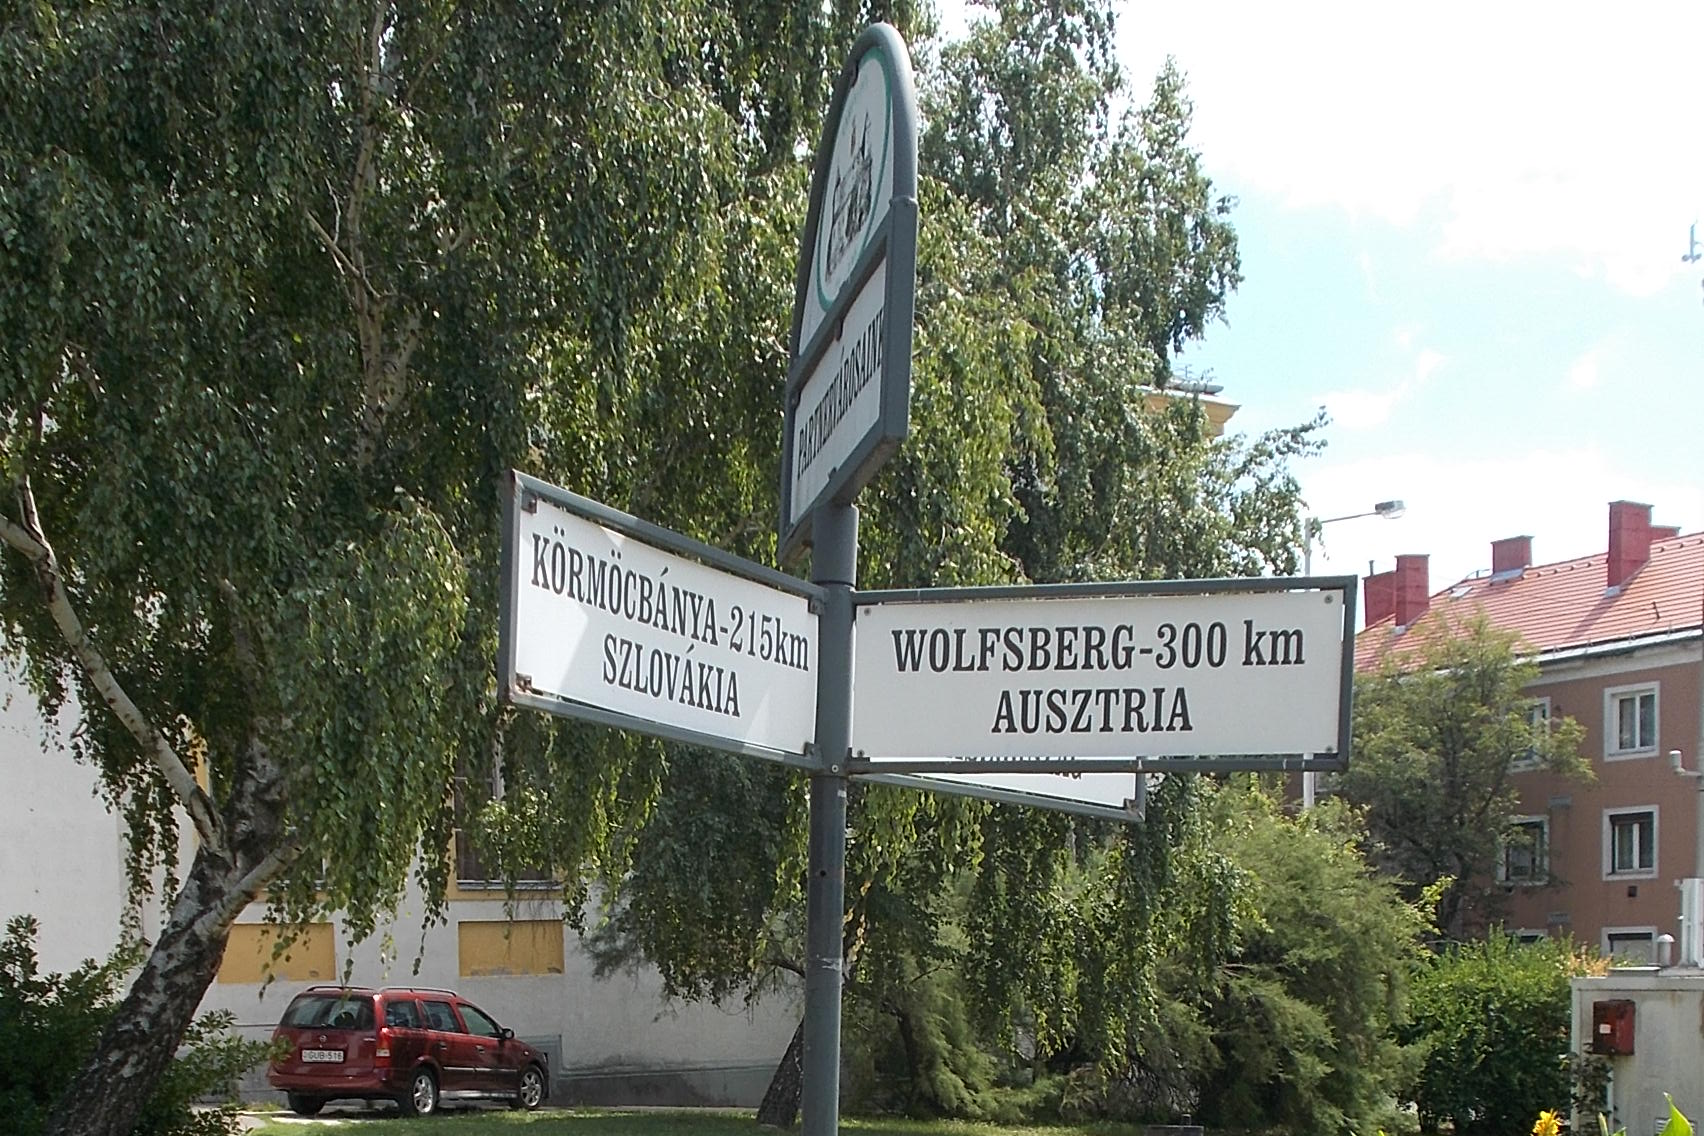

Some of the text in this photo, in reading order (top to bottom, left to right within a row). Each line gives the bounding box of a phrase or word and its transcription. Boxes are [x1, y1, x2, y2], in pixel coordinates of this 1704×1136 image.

[892, 620, 1305, 673] WOLFSBERG-300 km
[603, 644, 741, 717] SZLOVÁKIA
[991, 687, 1193, 733] AUSZTRIA
